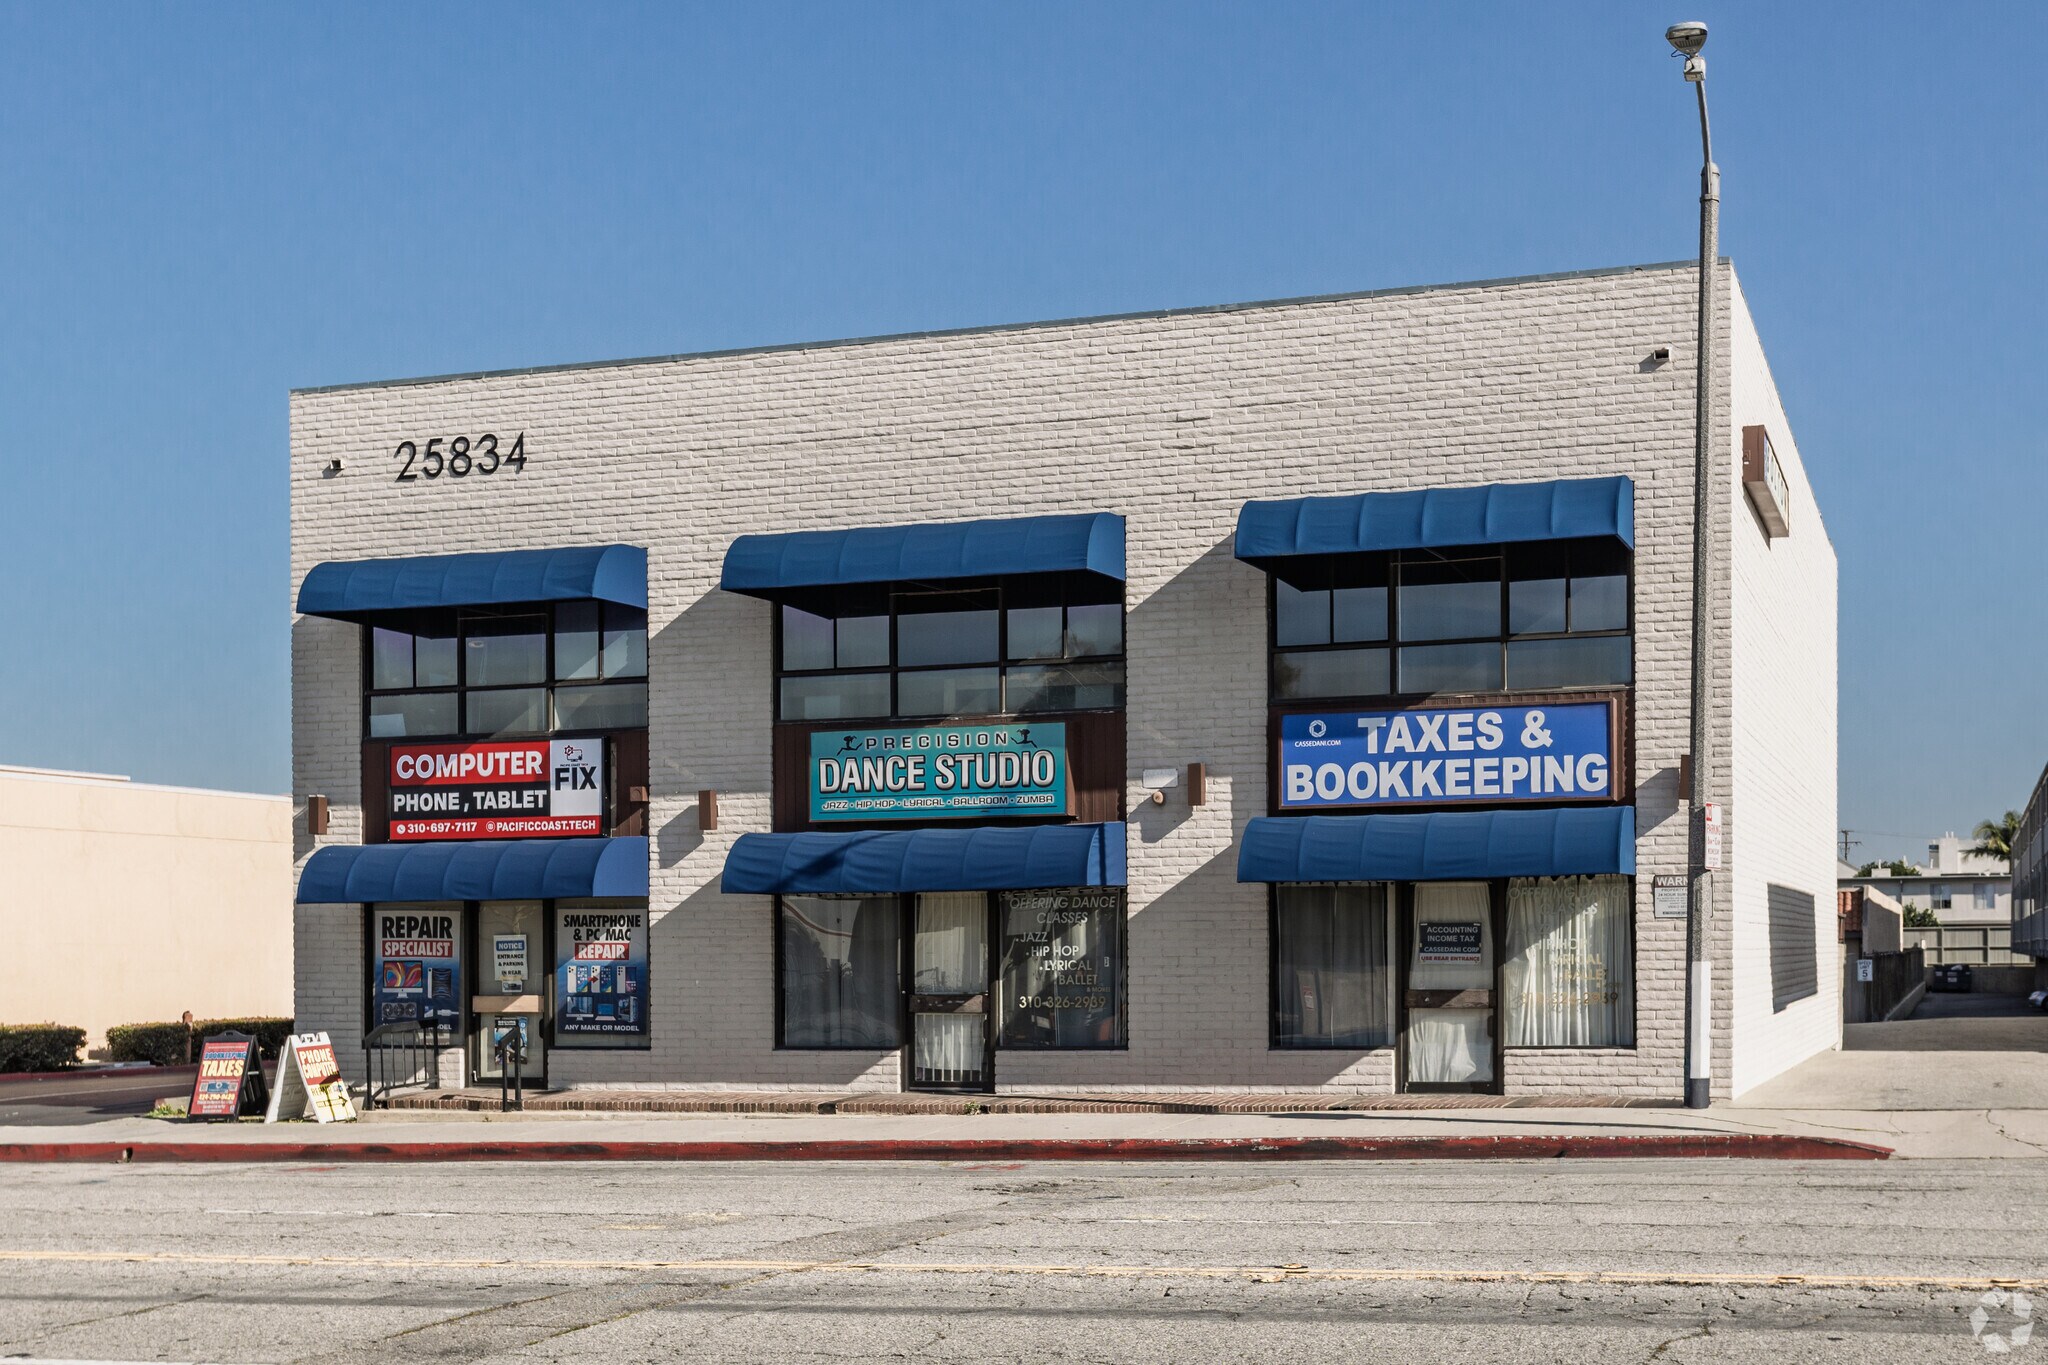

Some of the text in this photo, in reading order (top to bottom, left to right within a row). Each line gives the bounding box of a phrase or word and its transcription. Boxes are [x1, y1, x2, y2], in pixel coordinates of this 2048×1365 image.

[394, 431, 528, 481] 25834
[1357, 710, 1553, 754] TAXES &
[866, 732, 1007, 750] PRECISION
[1294, 740, 1341, 748] CASSEDANI.COM
[396, 751, 542, 779] COMPUTER
[819, 749, 1056, 793] DANCE STUDIO
[555, 766, 597, 790] FIX
[1287, 753, 1608, 801] BOOKKEEPING
[473, 790, 547, 810] TABLET
[823, 795, 1053, 810] JAZZ HIP HOP LYRICAL BALLROOM ZUMBA
[497, 820, 596, 832] PACIFICCOAST.TECH
[1010, 896, 1115, 909] OFFERING DANCE
[563, 914, 641, 928] SMARTPHONE
[1037, 912, 1088, 923] CLASSES
[382, 916, 453, 939] REPAIR
[573, 928, 631, 941] & PC MAC
[1020, 932, 1048, 942] JAZZ
[384, 942, 450, 956] SPECIALIST
[498, 942, 523, 950] NOTICE
[578, 943, 626, 959] REPAIR
[1031, 945, 1079, 957] HIP HOP
[1044, 959, 1093, 971] LYRICAL
[1059, 974, 1098, 985] BALLET
[1862, 969, 1868, 977] 5
[1019, 996, 1106, 1008] 310-326-2939
[299, 1048, 333, 1065] PHONE
[201, 1060, 244, 1077] TAXES
